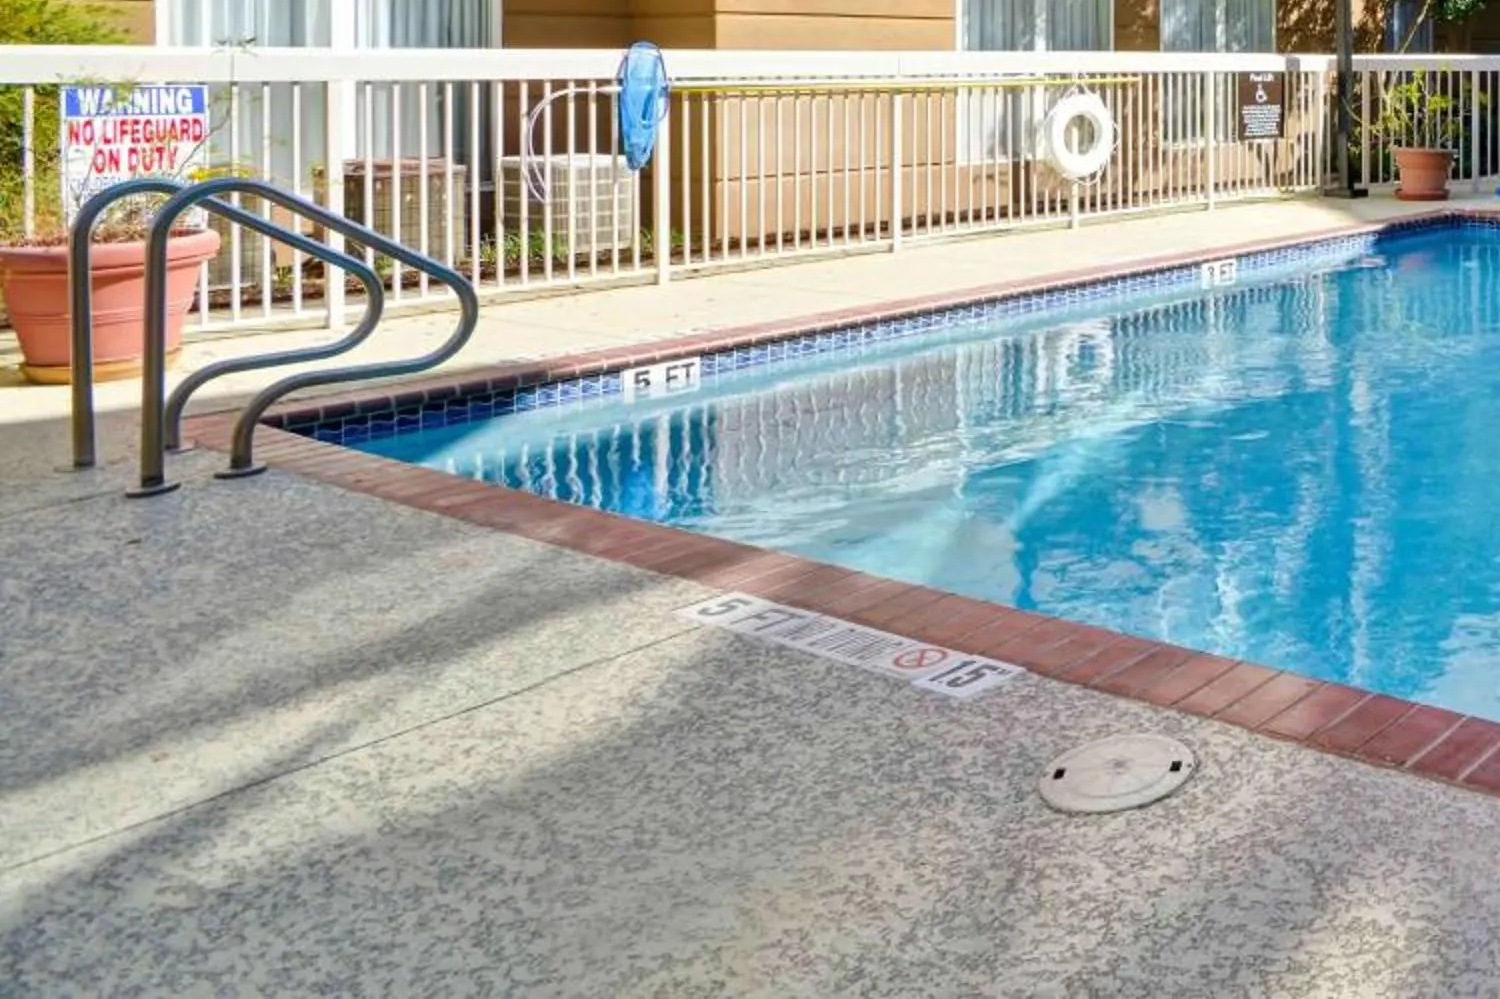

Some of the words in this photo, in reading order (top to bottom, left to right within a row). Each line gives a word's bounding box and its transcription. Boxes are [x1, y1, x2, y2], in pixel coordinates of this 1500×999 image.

[67, 119, 95, 144] NO
[103, 118, 203, 144] LIFEGUARD
[93, 147, 119, 174] ON
[128, 146, 178, 173] DUTY
[634, 369, 651, 389] 5
[665, 362, 695, 390] FT
[697, 598, 752, 616] 5
[729, 608, 806, 632] FT
